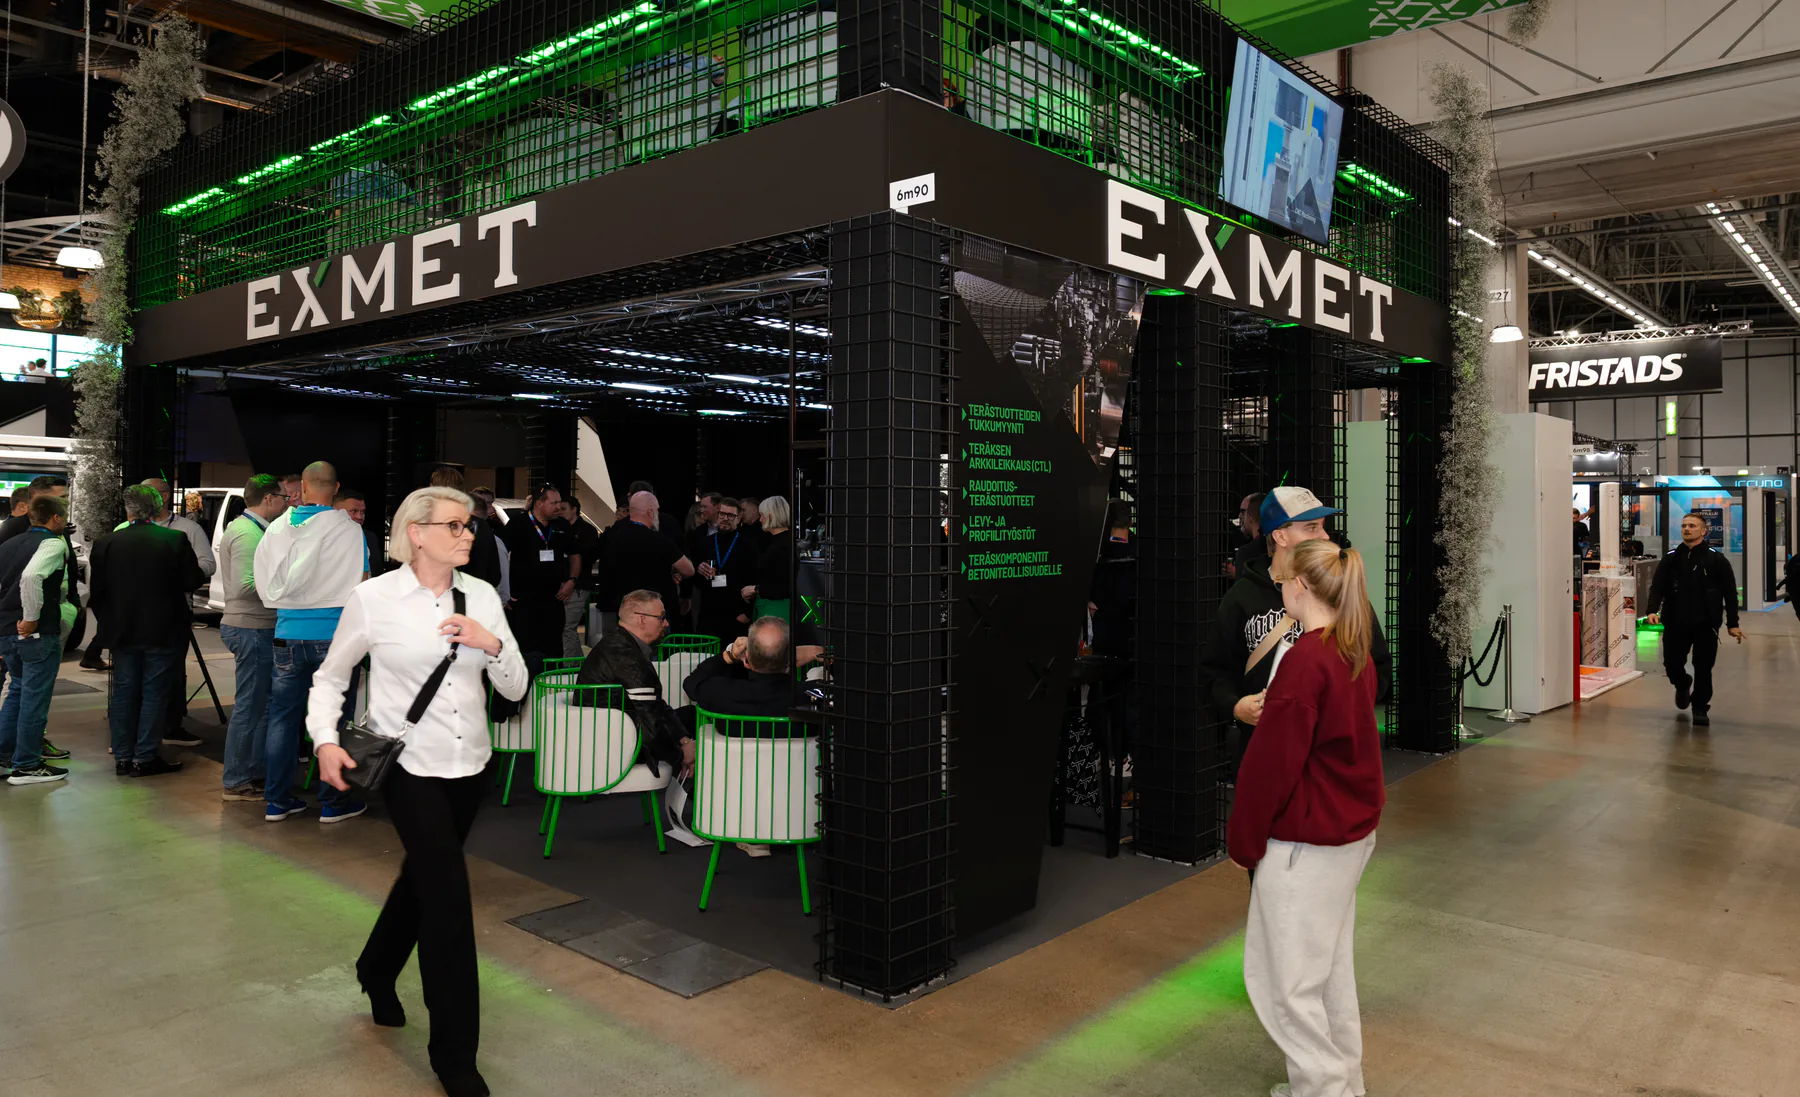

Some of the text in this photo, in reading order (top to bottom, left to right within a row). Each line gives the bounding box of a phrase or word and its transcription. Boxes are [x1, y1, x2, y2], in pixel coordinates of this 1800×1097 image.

[896, 184, 929, 201] 6m90
[1108, 179, 1393, 342] EXMET
[246, 200, 537, 341] EXMET
[1528, 353, 1682, 389] FRISTADS
[968, 403, 1041, 422] TERÄSTUOTTEIDEN
[968, 418, 1025, 434] TUKKUMYYNTI
[968, 441, 1012, 457] TERÄKSEN
[969, 480, 1018, 492] RAUDOITUS-
[969, 492, 1035, 506] TERÄSTUOTTEET
[968, 526, 1036, 542] PROFIILITYÖSTÖT
[968, 551, 1049, 566] TERÄSKOMPONENTIT
[968, 564, 1062, 580] BETONITEOLLISUUDELLE
